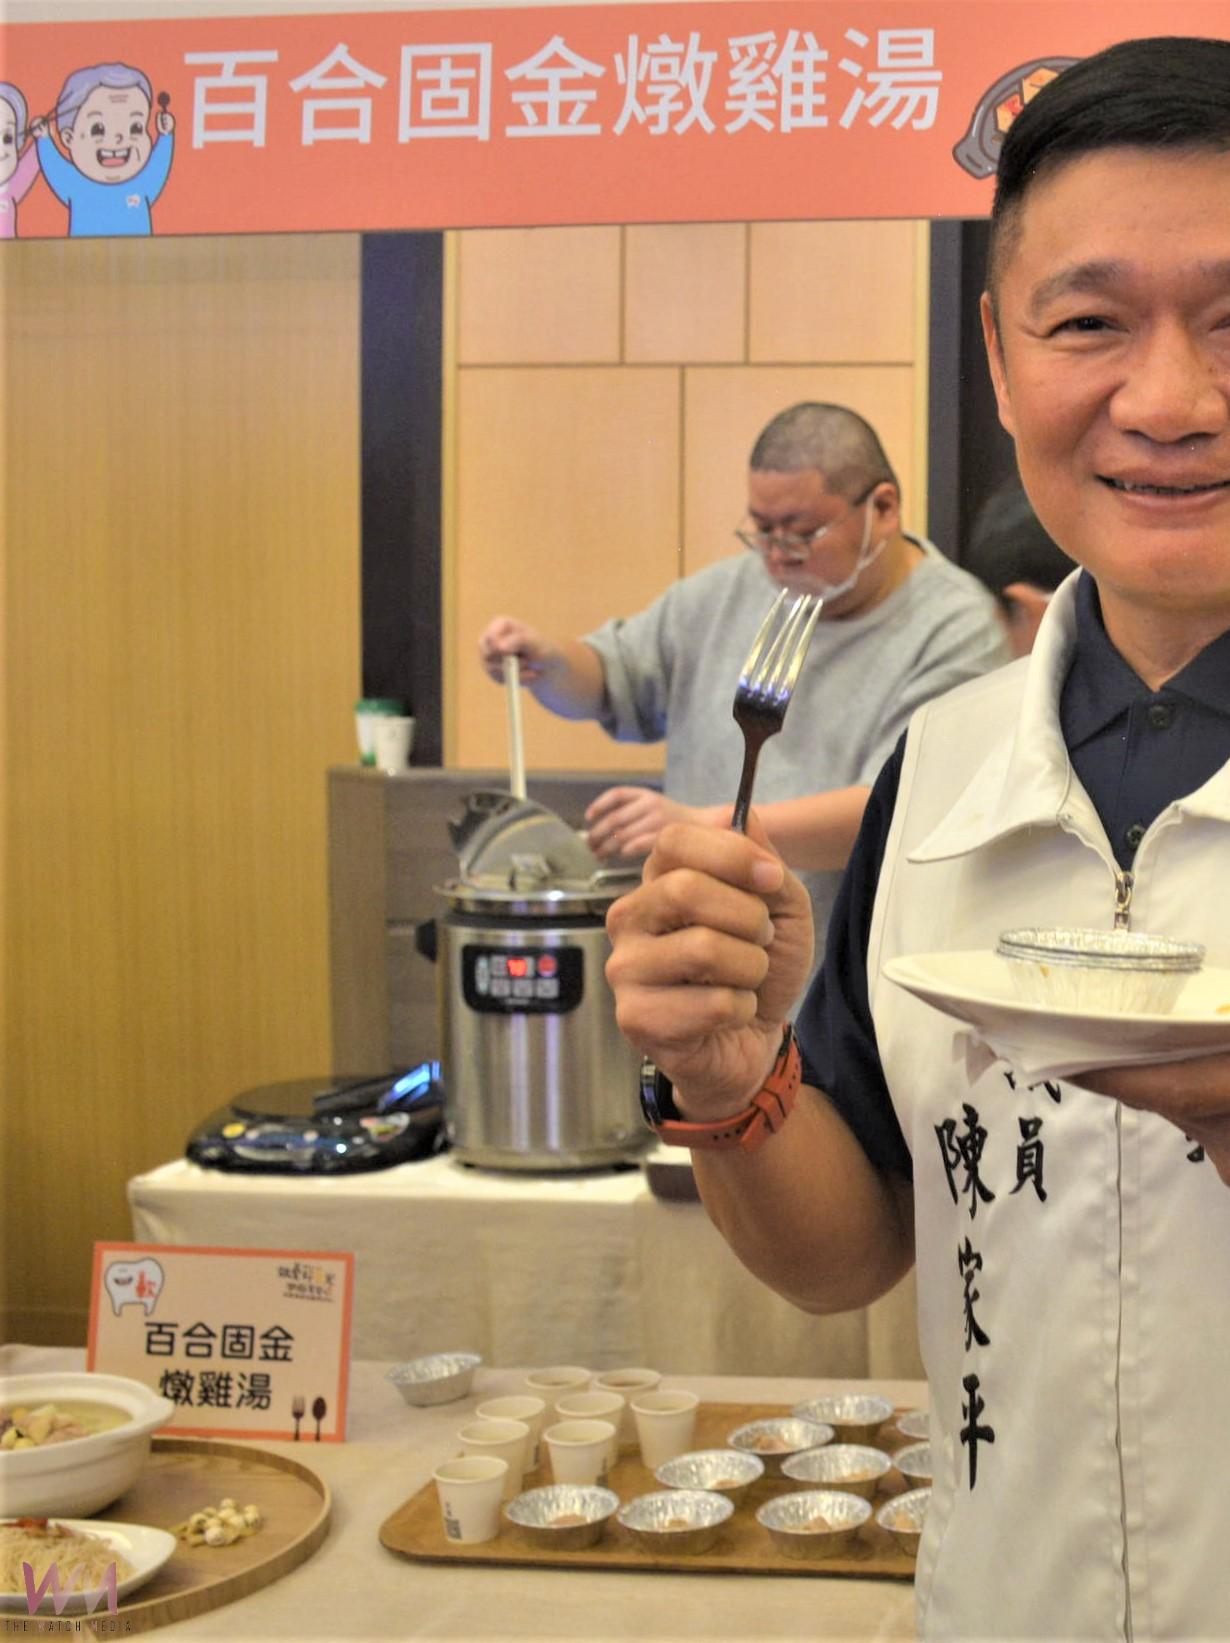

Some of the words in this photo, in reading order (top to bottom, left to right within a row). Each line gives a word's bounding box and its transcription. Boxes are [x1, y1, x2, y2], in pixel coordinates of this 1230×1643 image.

[184, 28, 943, 149] 百合固金燉雞湯
[934, 1103, 996, 1491] 陳家平
[145, 1321, 294, 1362] 百合固金
[159, 1368, 271, 1410] 燉雞湯
